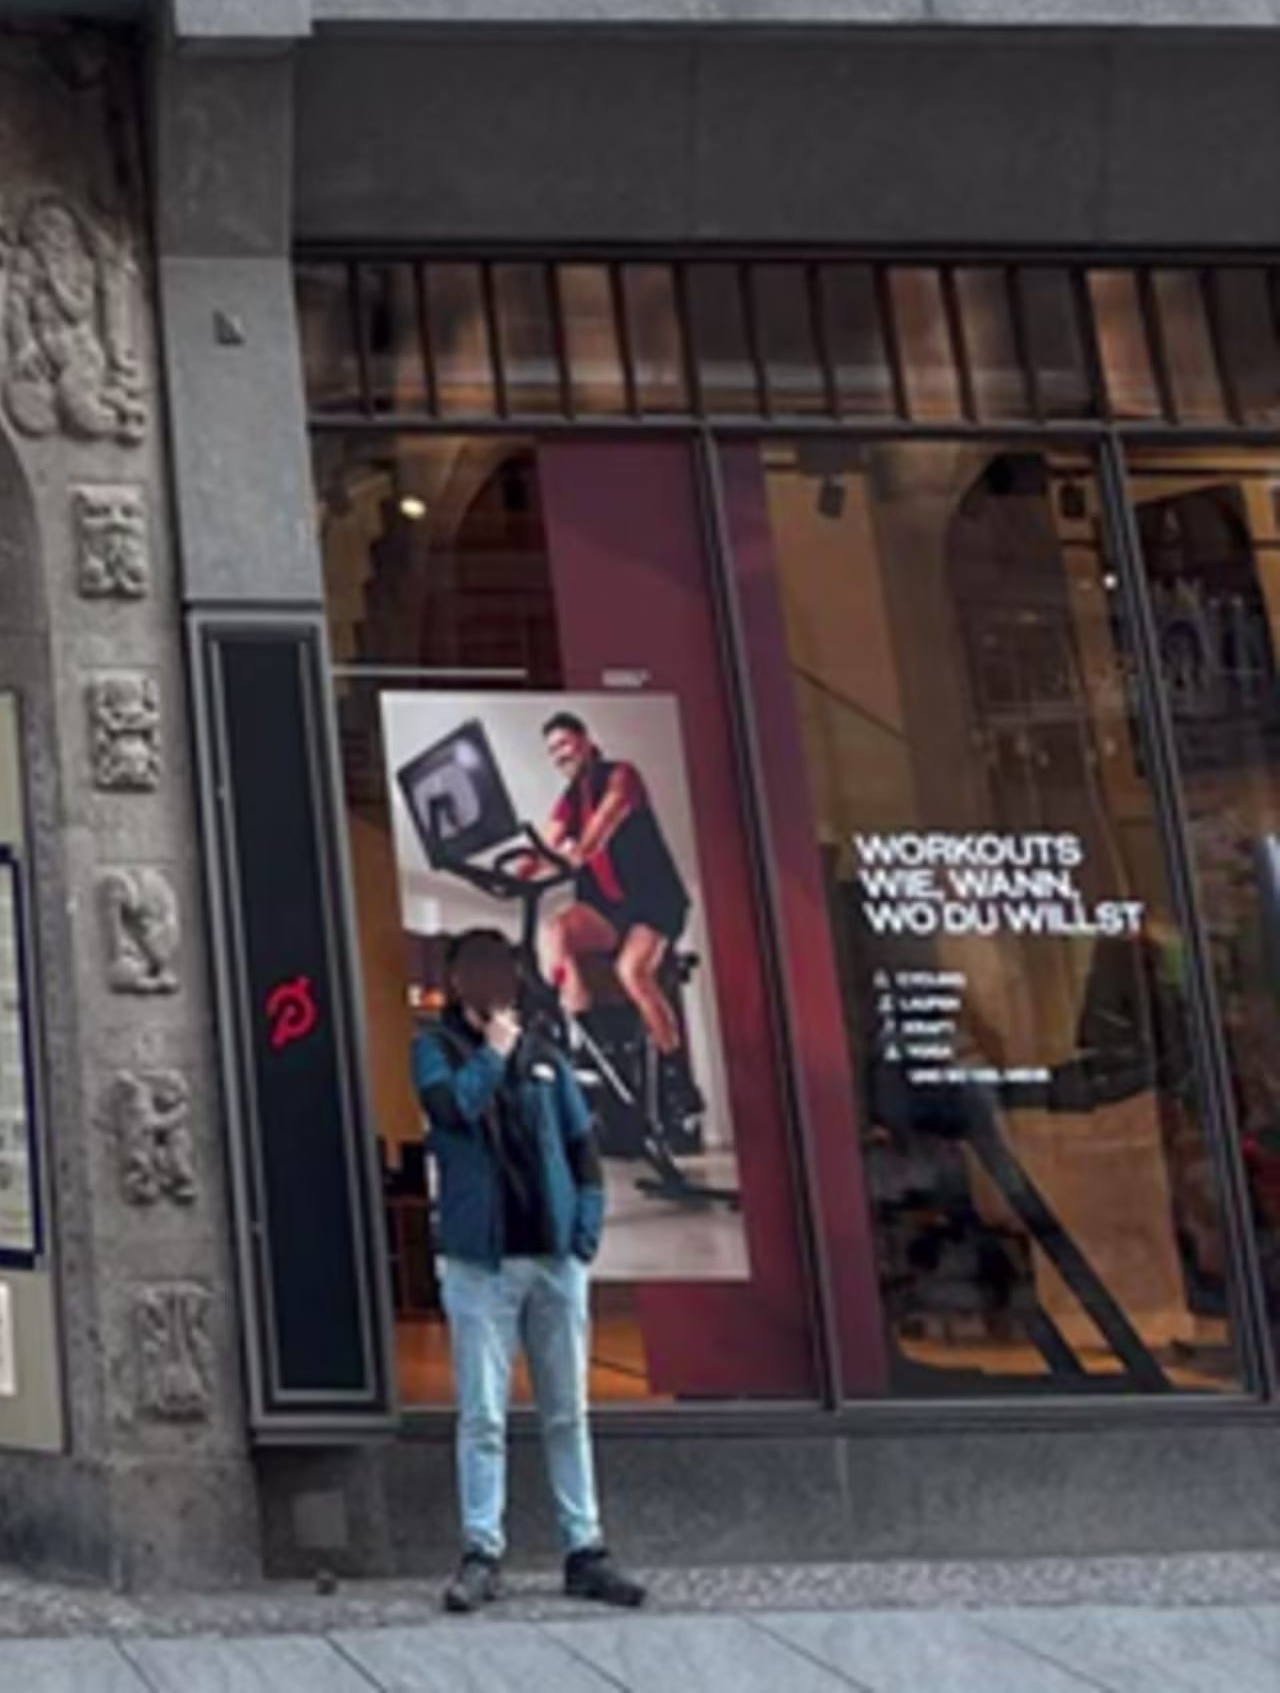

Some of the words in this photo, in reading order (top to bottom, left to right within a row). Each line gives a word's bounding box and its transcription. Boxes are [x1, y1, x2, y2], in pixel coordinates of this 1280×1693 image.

[855, 835, 1081, 864] WORKOUTS
[860, 870, 944, 900] WIE,
[948, 870, 1080, 900] WANN,
[863, 904, 936, 933] WO
[943, 904, 998, 933] DU
[1003, 902, 1144, 934] WILLST
